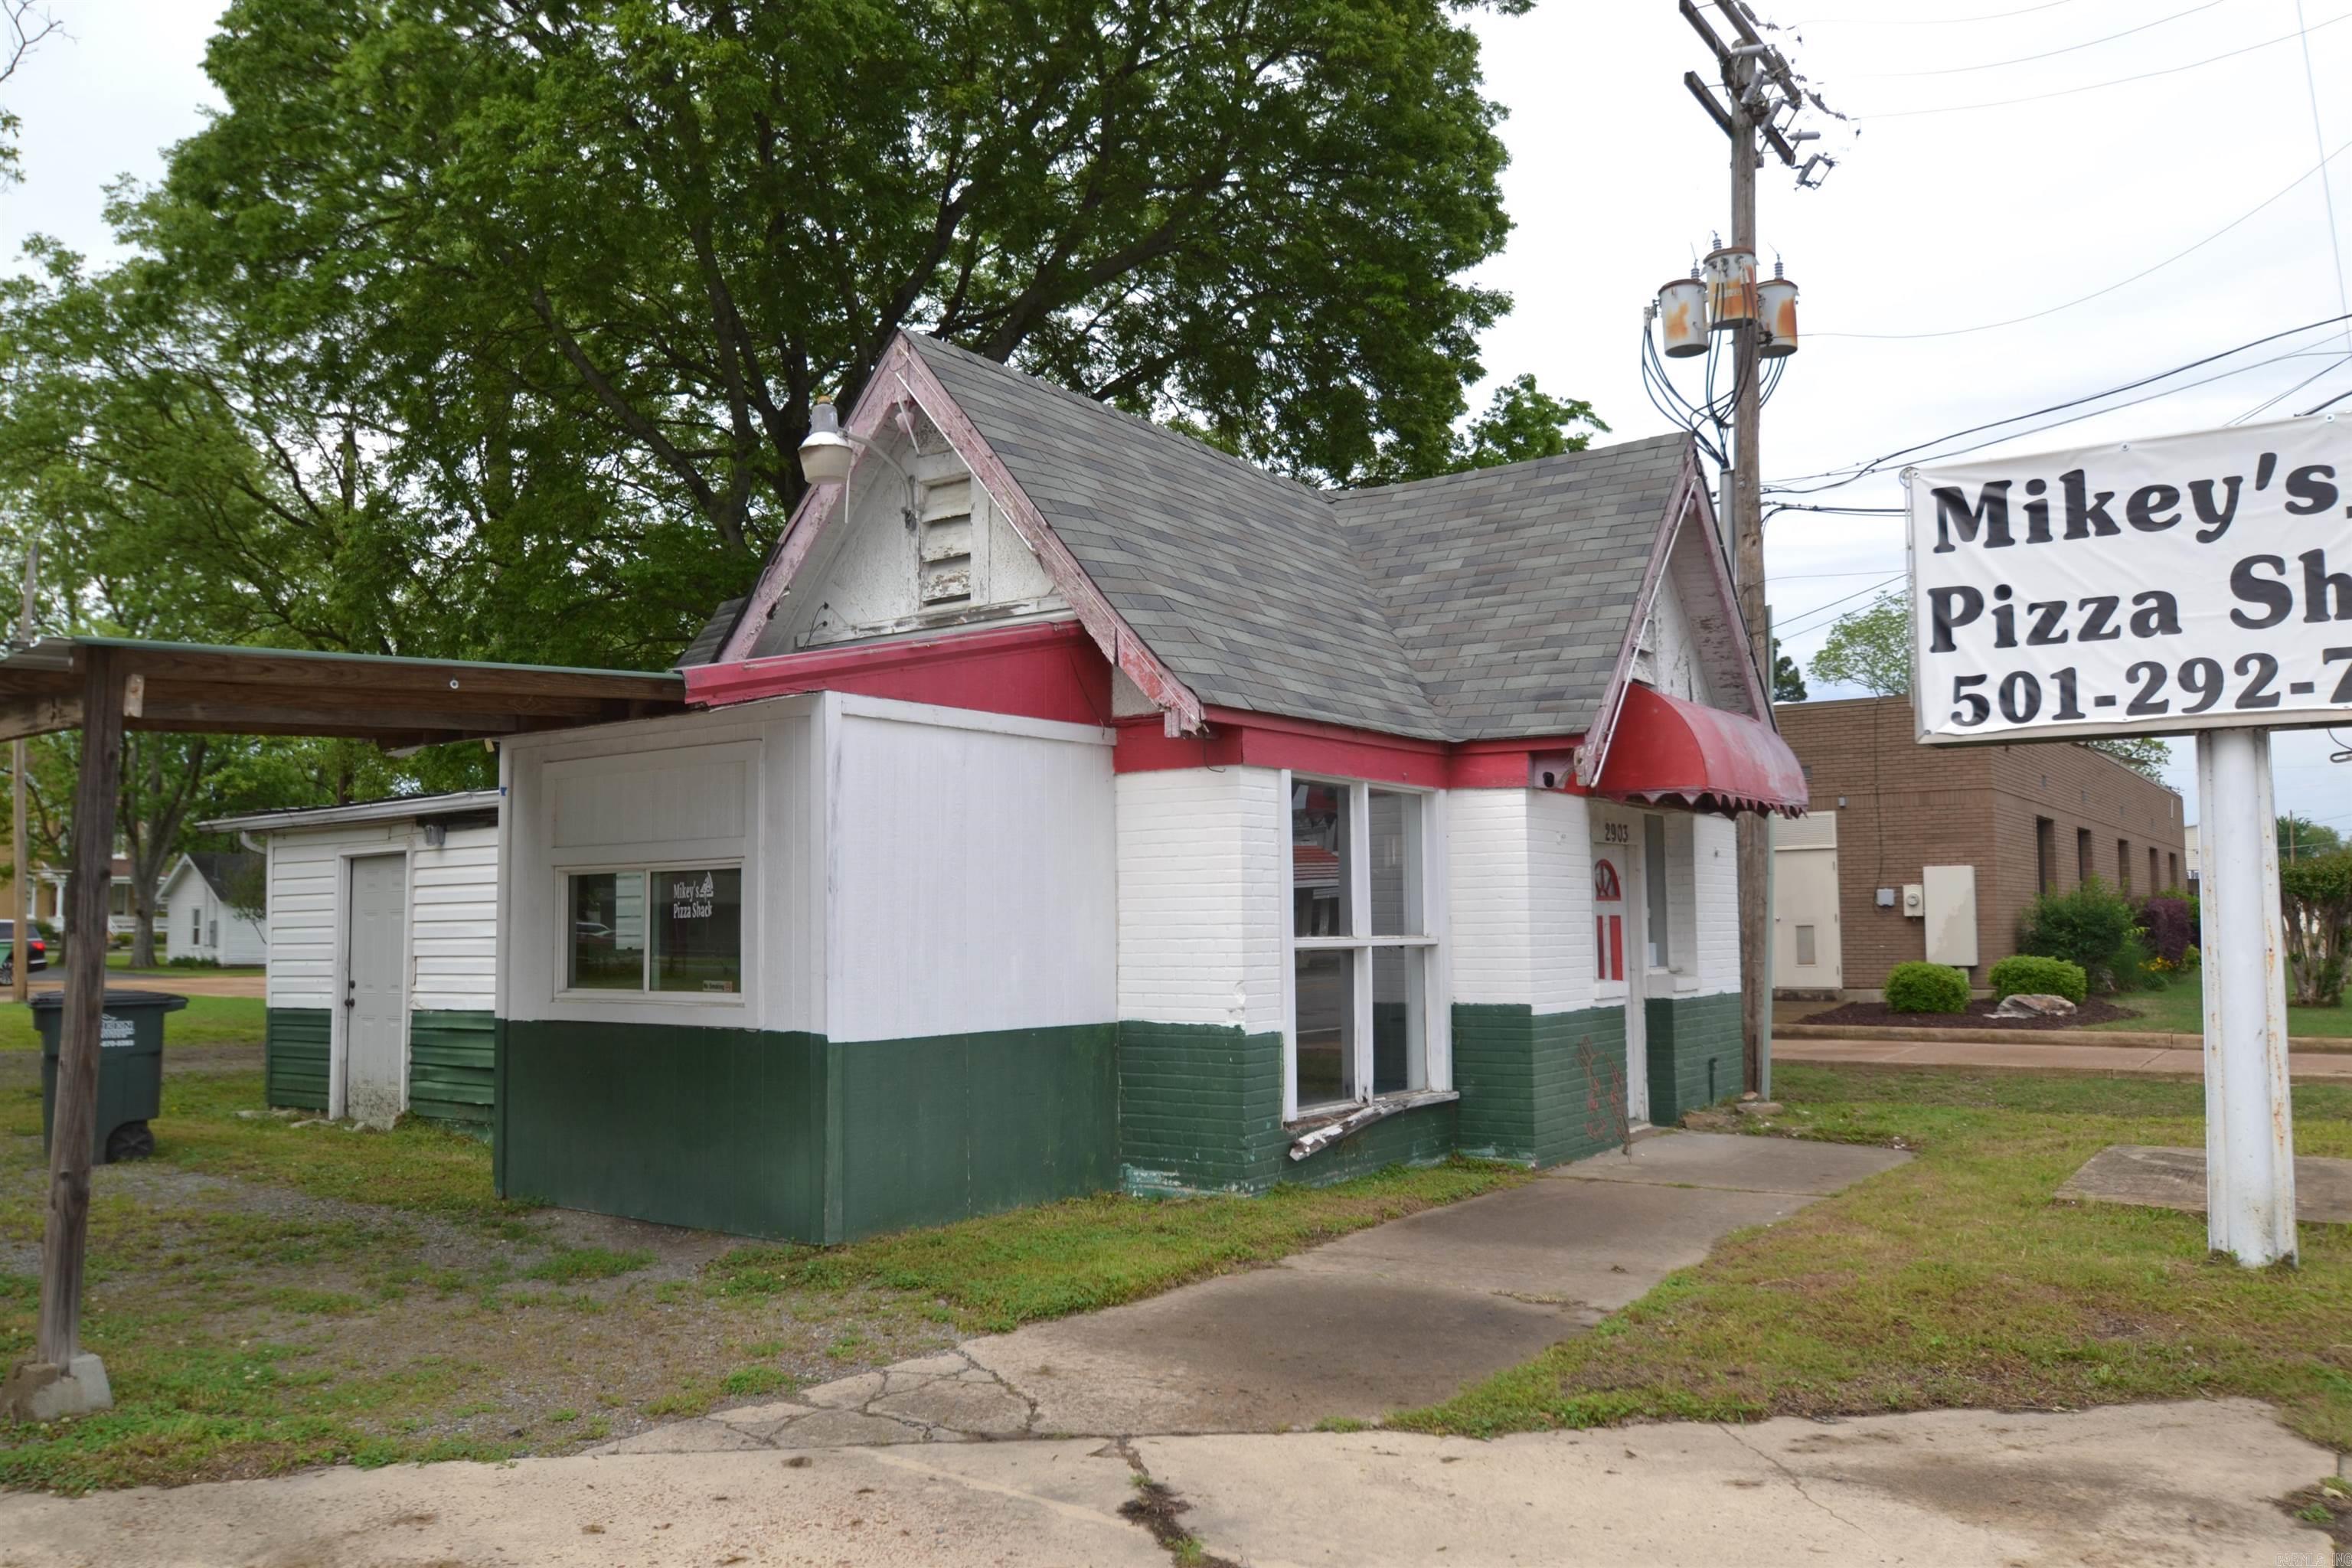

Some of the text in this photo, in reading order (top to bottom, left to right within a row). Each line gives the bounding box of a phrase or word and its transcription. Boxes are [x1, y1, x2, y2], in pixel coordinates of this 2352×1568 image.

[1930, 452, 2338, 554] Mikey's
[1926, 583, 2183, 654] Pizza
[1605, 822, 1628, 843] 2903
[673, 880, 700, 902] Mikey's
[673, 900, 712, 919] Pizza Shack
